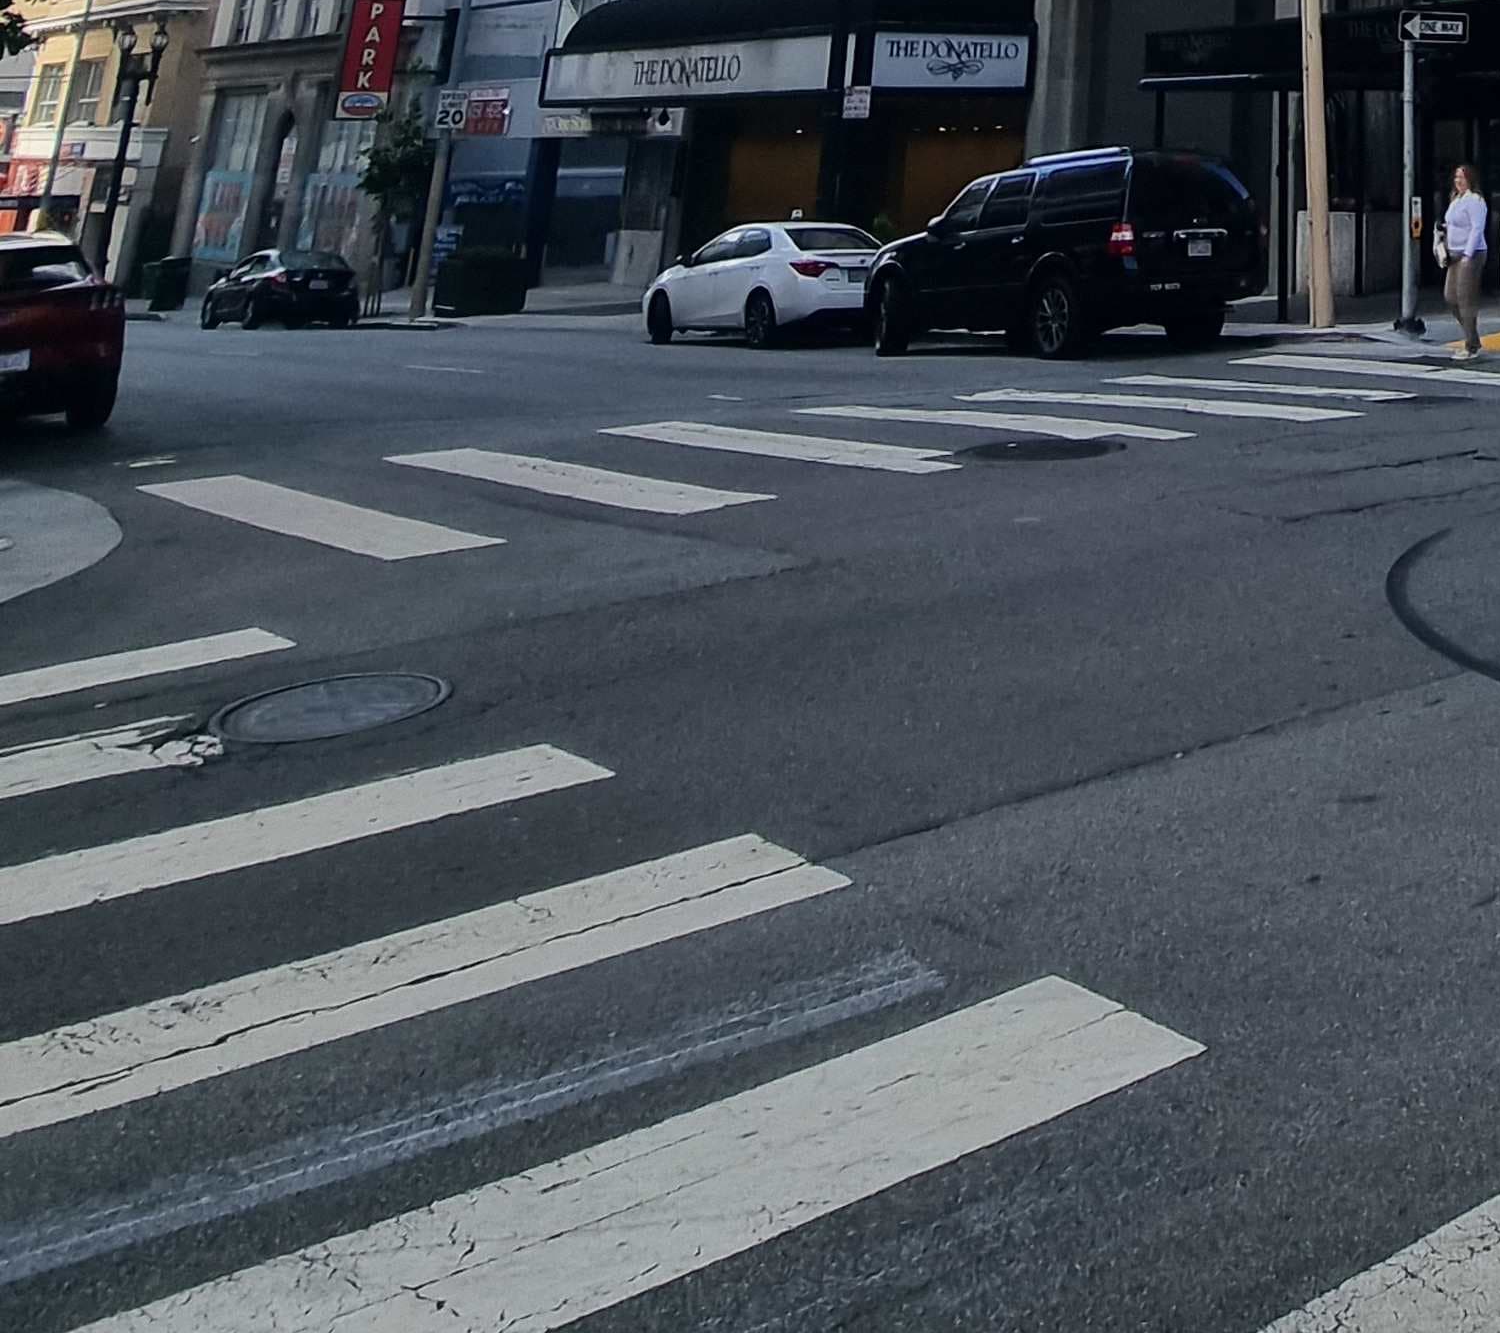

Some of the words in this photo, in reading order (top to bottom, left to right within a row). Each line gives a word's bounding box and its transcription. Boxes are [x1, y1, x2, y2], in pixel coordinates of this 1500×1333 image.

[356, 2, 385, 90] PARK
[886, 39, 920, 58] THE
[922, 37, 1020, 62] DONATELLO
[633, 60, 658, 86] THE
[660, 55, 741, 88] DONATELLO
[437, 109, 464, 126] 20
